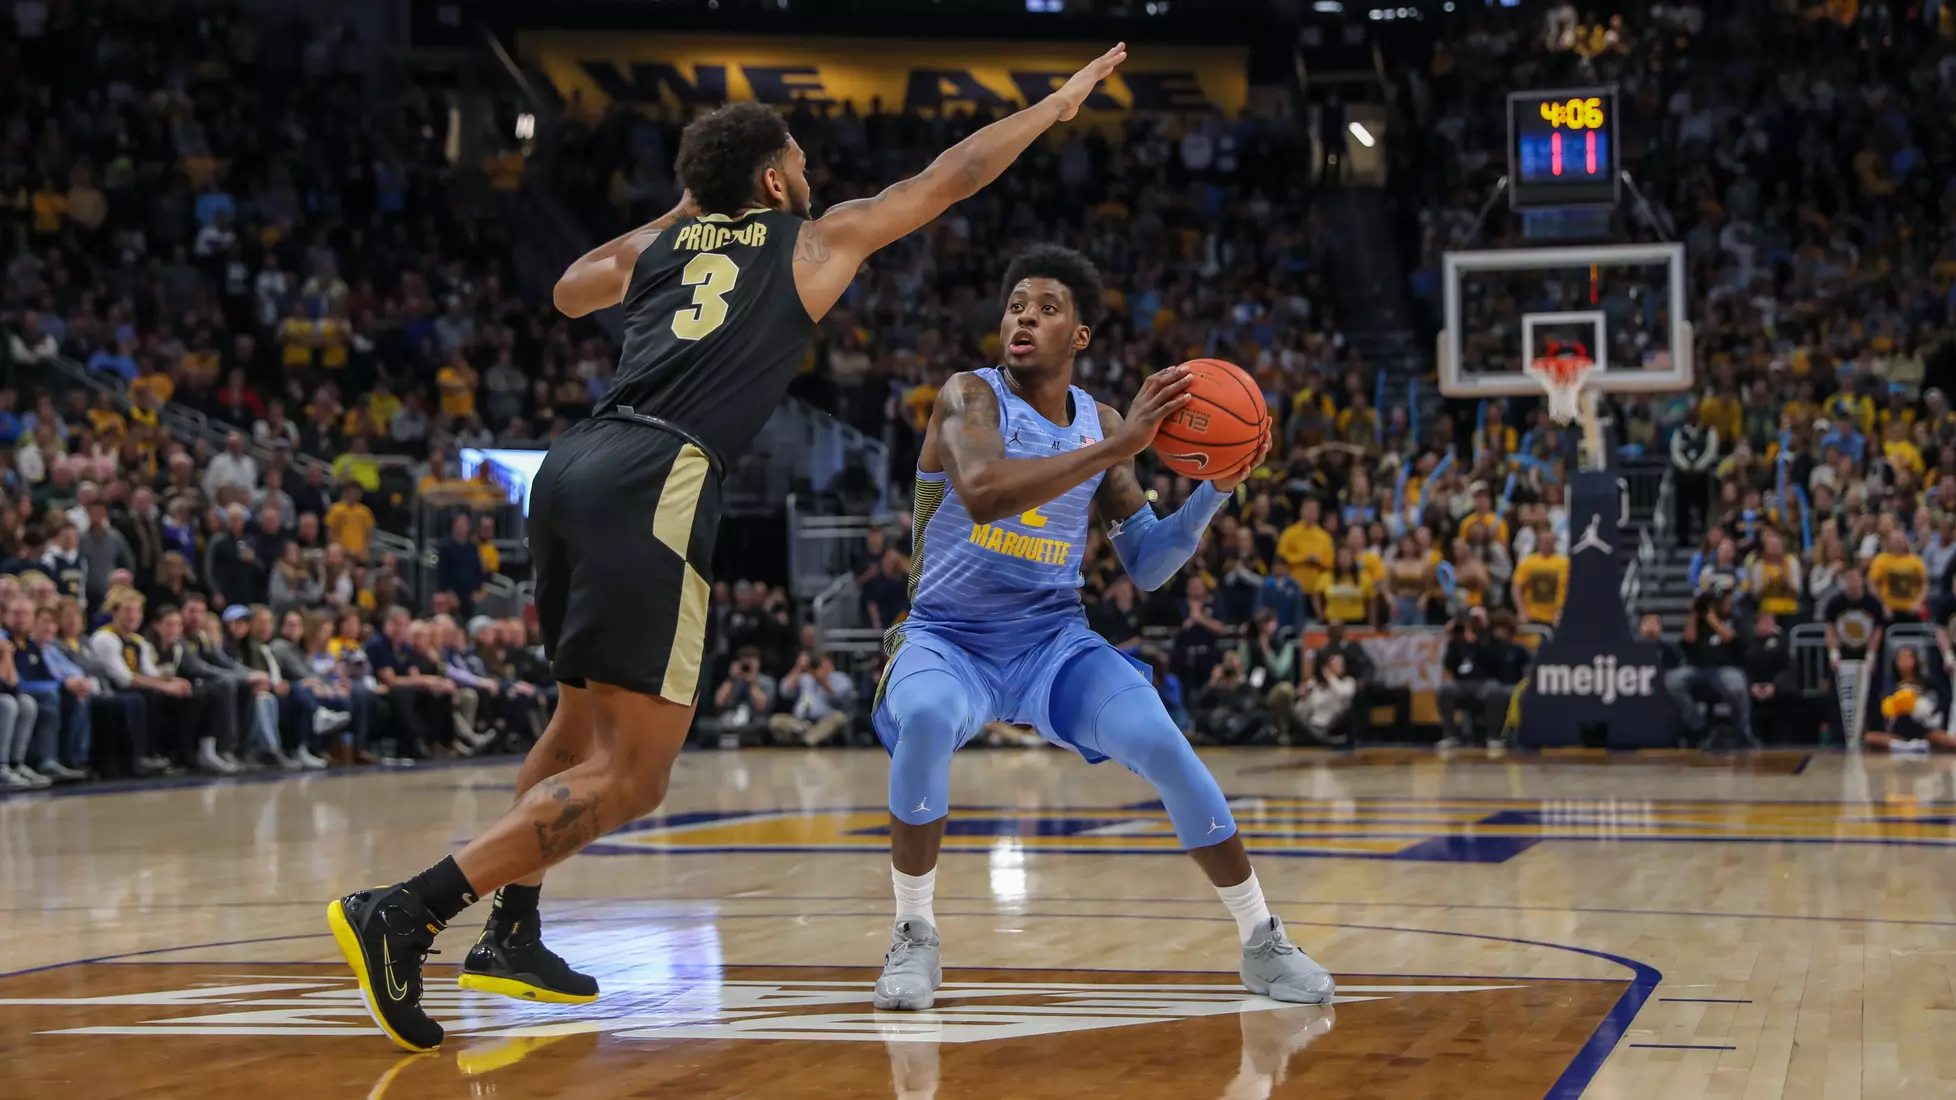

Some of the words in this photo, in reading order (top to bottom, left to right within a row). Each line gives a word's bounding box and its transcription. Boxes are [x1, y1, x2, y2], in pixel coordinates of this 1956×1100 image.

[1540, 97, 1604, 130] 4:06
[1551, 130, 1597, 176] 11
[671, 252, 740, 341] 3
[969, 523, 1071, 566] MARQUETTE
[1537, 654, 1657, 705] meijer
